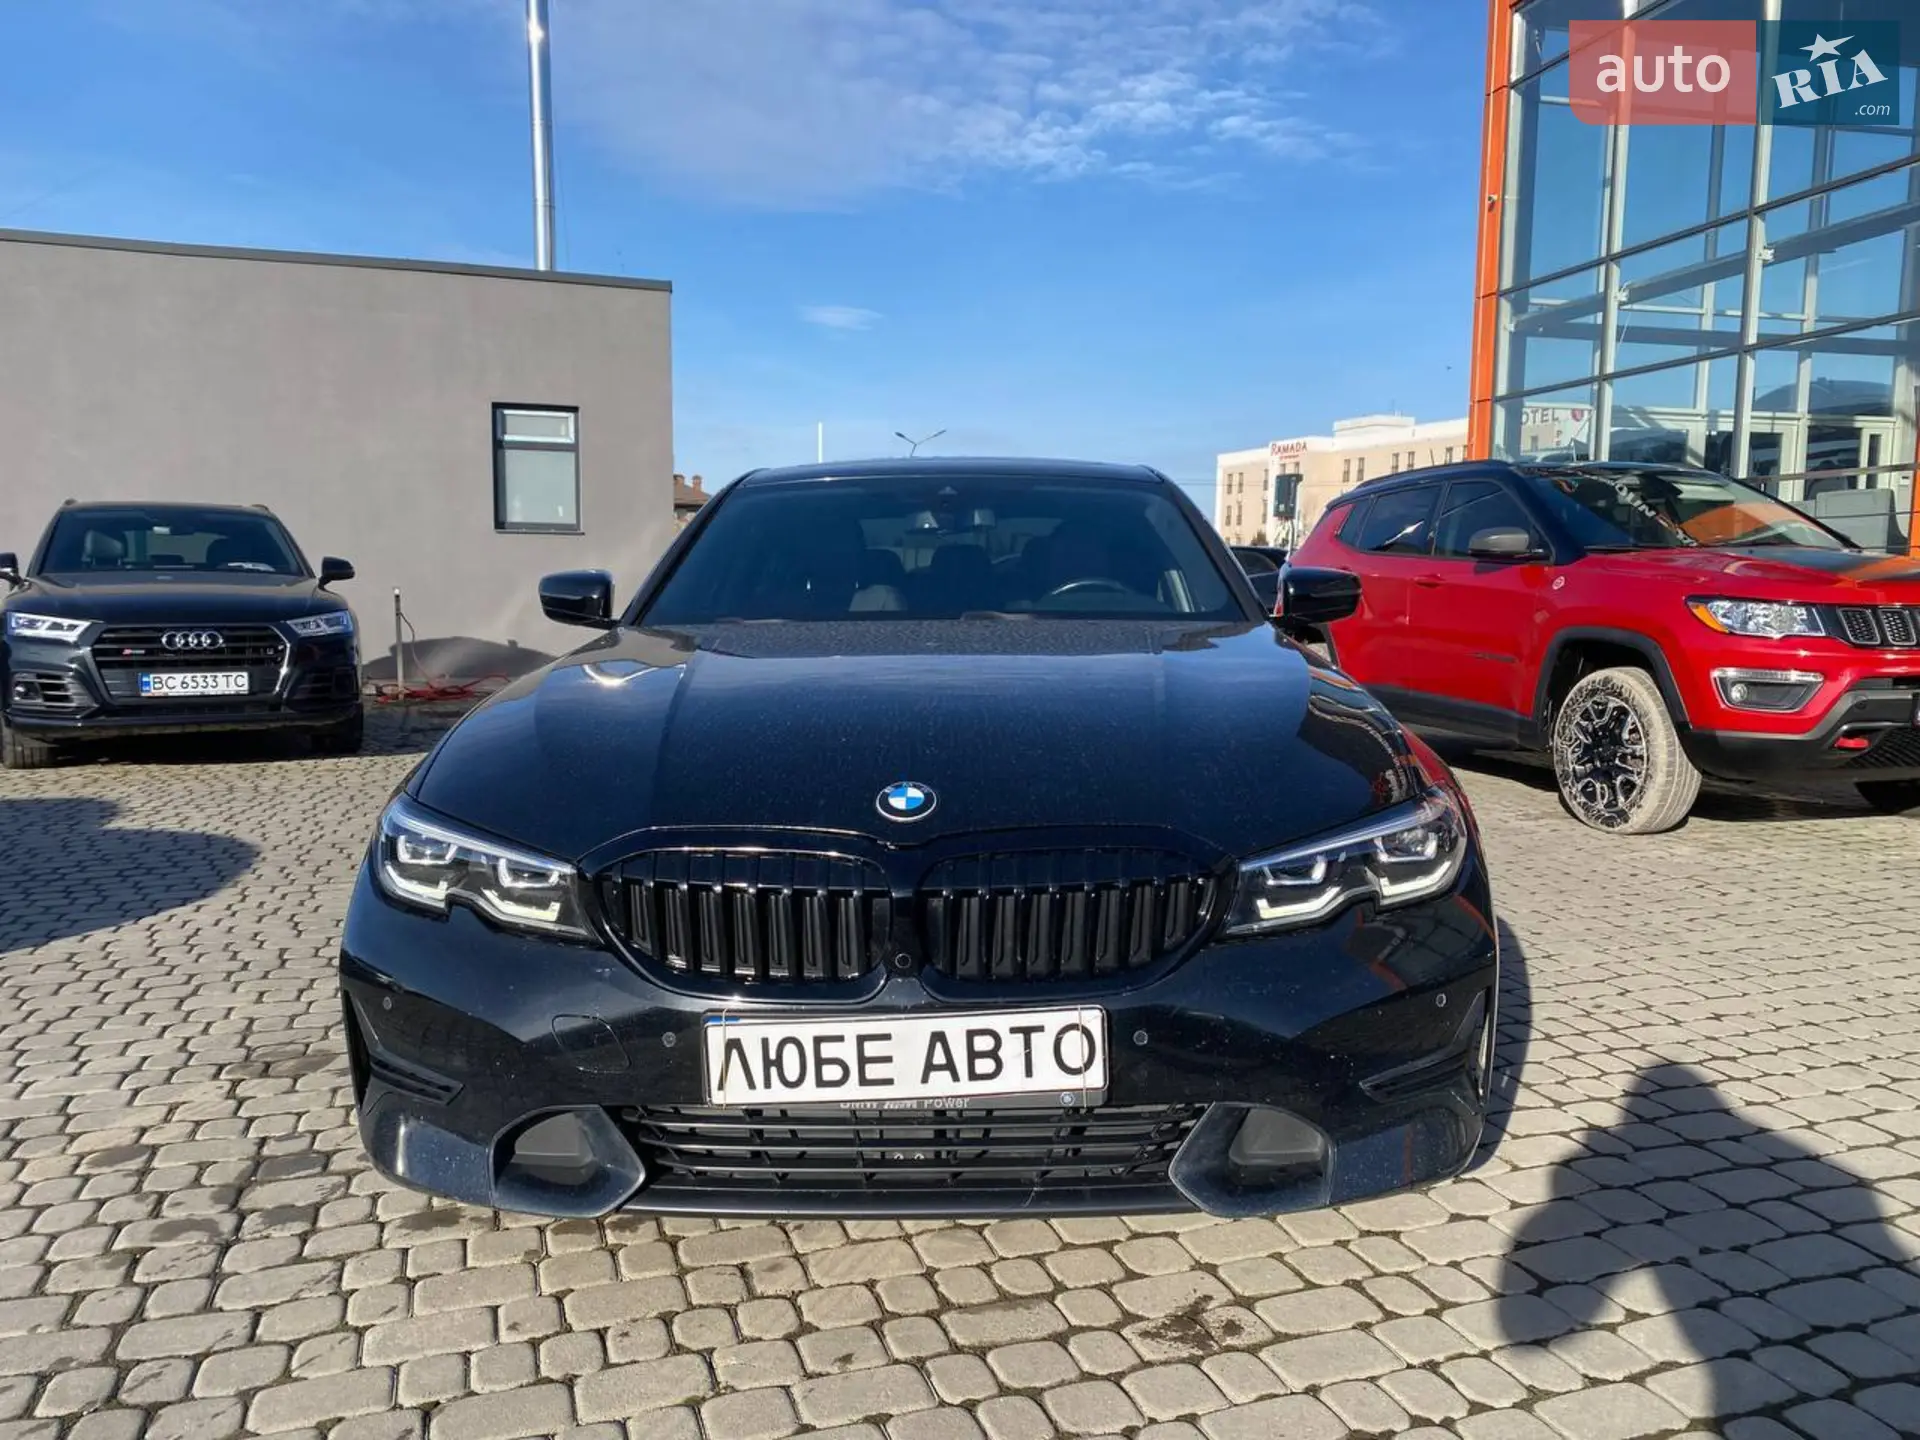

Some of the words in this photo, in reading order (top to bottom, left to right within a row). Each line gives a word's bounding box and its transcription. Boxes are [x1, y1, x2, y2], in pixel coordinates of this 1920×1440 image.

[1271, 441, 1308, 456] RAMADA
[152, 675, 177, 691] BC
[180, 674, 219, 690] 6533
[222, 674, 246, 689] TC
[717, 1032, 895, 1091] ЛЮБЕ
[920, 1022, 1097, 1085] АВТО
